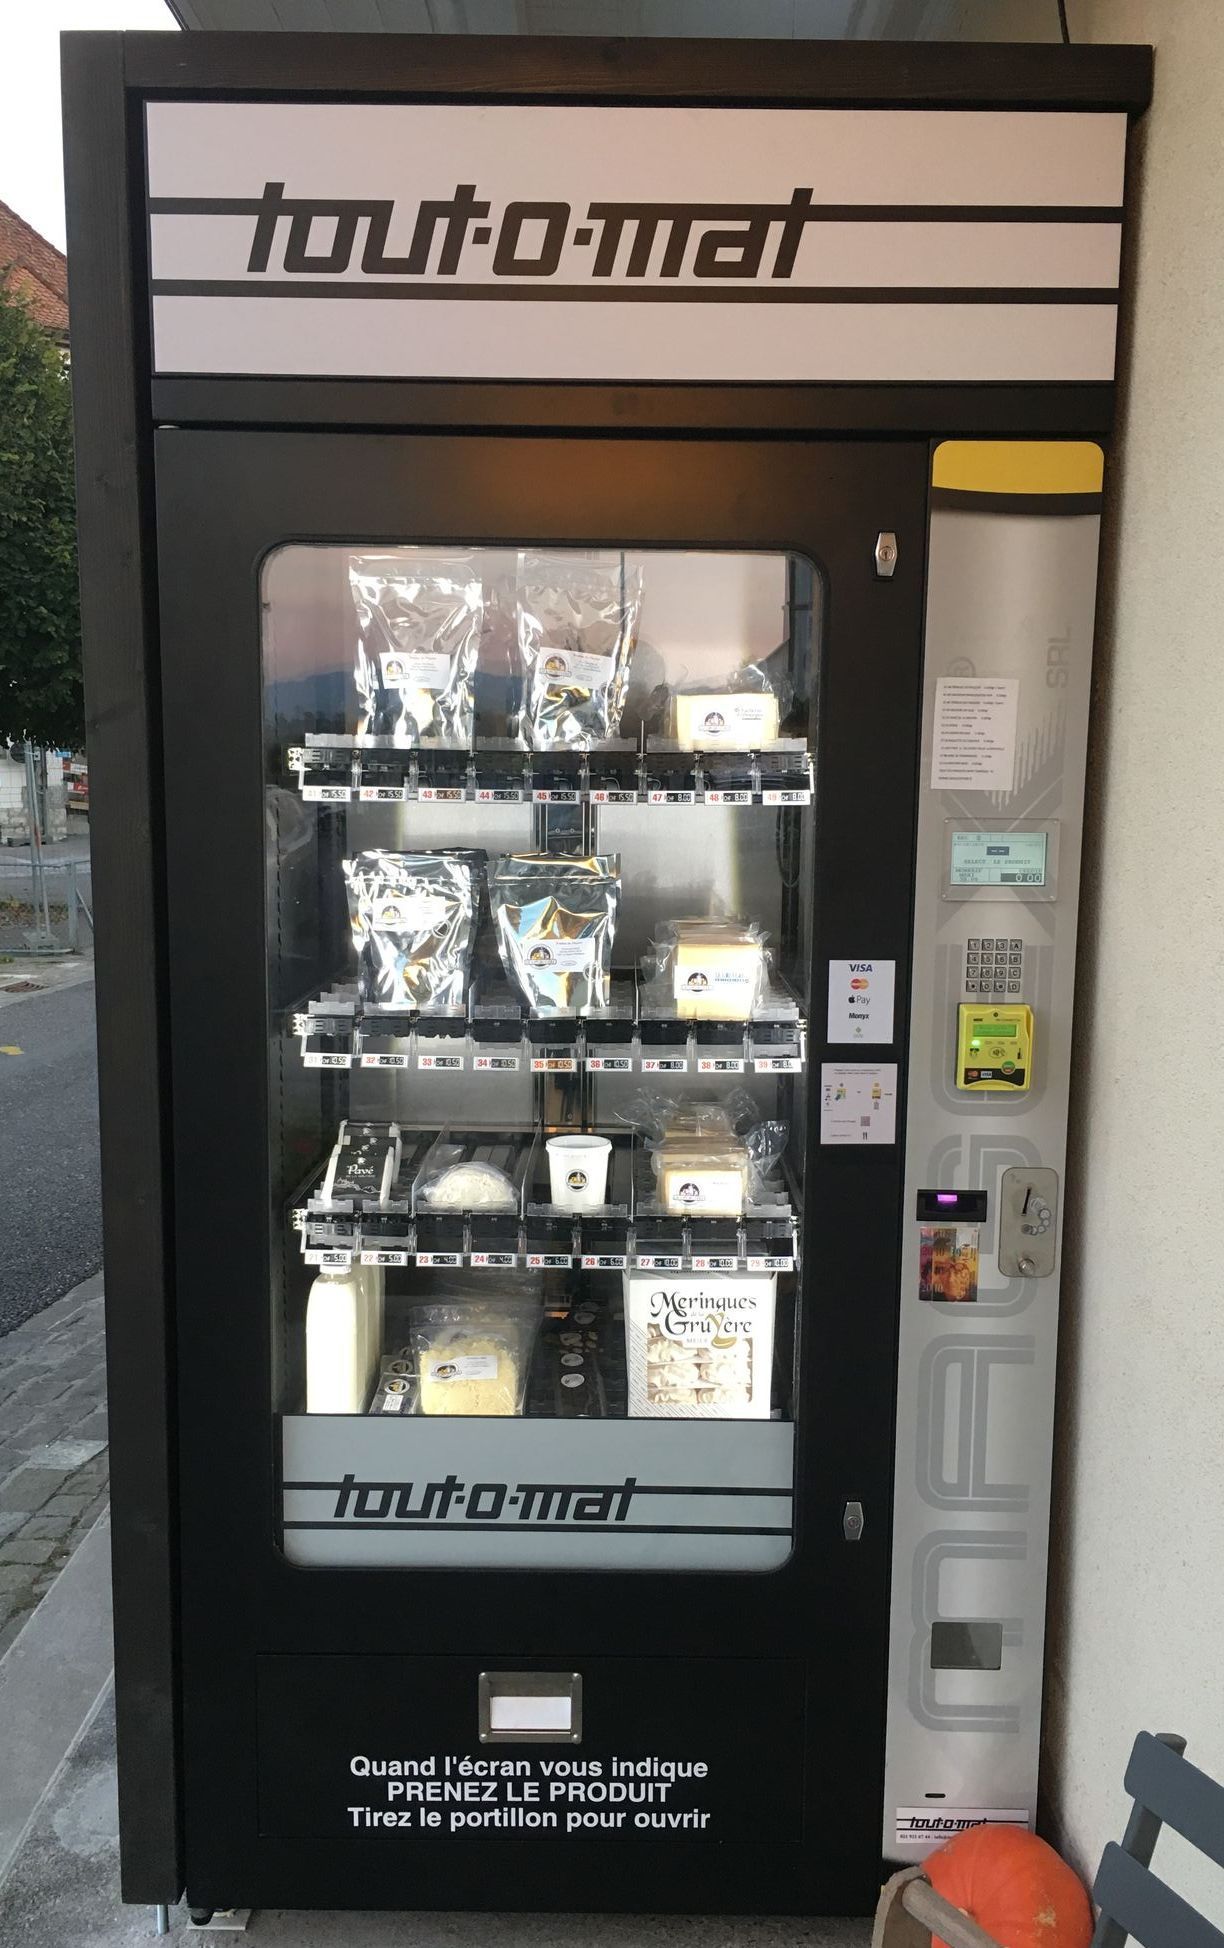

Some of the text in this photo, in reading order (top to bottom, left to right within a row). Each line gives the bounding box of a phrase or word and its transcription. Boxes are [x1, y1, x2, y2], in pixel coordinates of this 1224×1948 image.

[848, 964, 873, 972] VISA
[857, 995, 871, 1005] Pay
[849, 1012, 870, 1020] Monyx
[346, 1164, 374, 1175] Pavé
[650, 1291, 757, 1318] Meringues
[350, 1756, 709, 1782] Quand l'écran vous indique
[388, 1781, 672, 1803] PRENEZ LE PRODUIT
[348, 1807, 711, 1832] Tirez le portillon pour ouvrir
